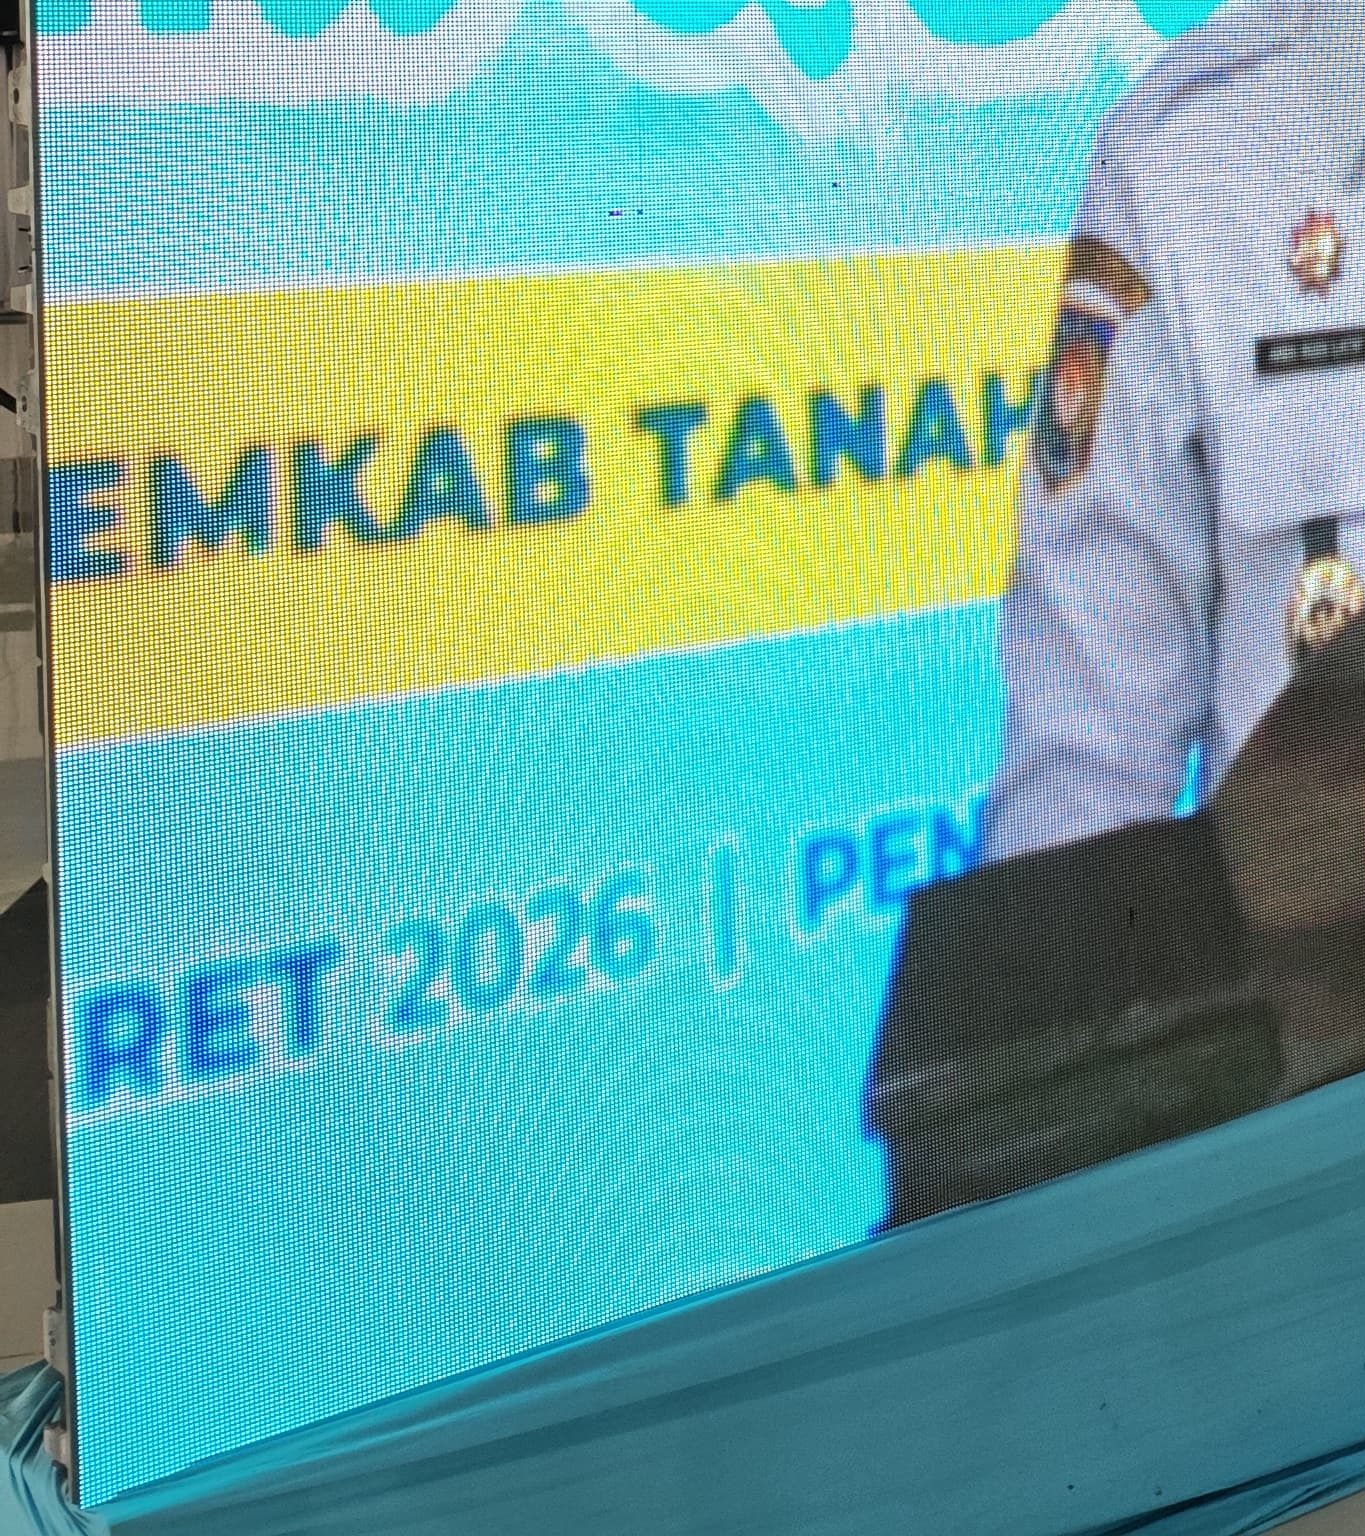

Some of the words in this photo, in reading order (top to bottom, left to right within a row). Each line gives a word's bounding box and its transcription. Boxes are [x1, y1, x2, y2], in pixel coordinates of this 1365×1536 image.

[51, 414, 590, 582] EMKAB
[82, 940, 342, 1105] RET
[385, 875, 656, 1032] 2026
